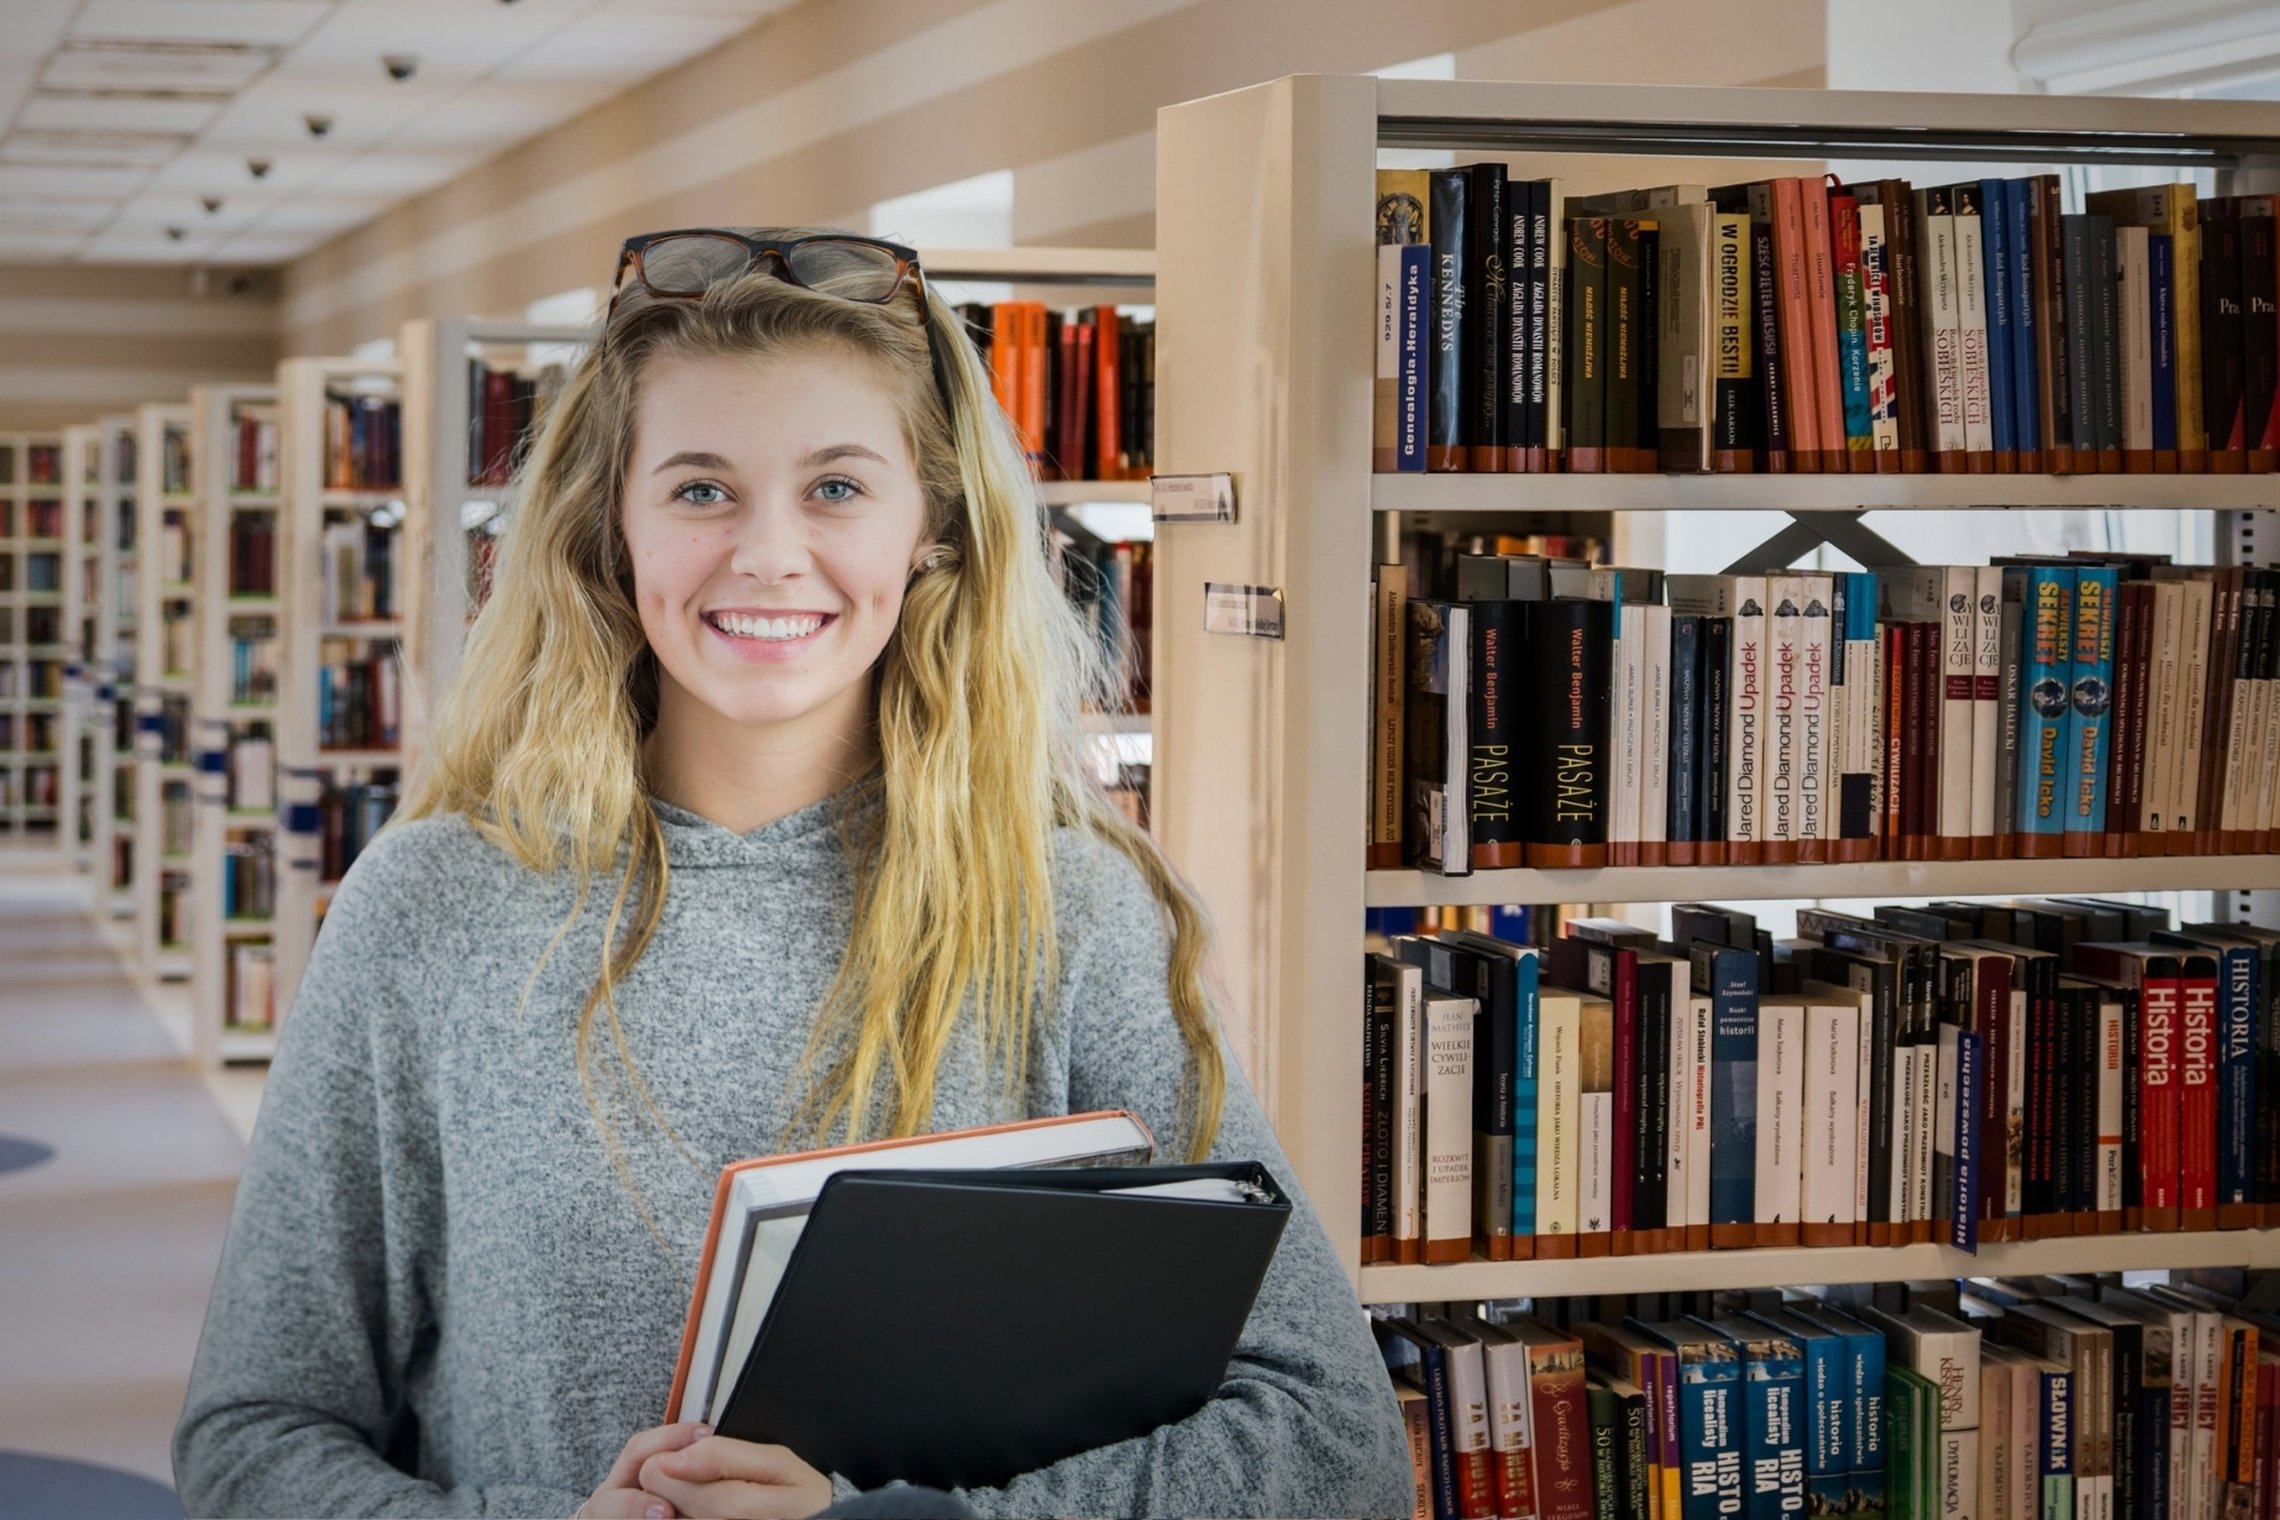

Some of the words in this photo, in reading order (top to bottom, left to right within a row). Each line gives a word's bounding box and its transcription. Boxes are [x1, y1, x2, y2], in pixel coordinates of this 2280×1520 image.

[1513, 214, 1526, 246] ANDREW
[1532, 214, 1547, 246] ANDREW
[1721, 223, 1738, 239] W
[1938, 232, 1949, 272] Aleksandra
[1966, 232, 1977, 272] Aleksandra
[1513, 248, 1526, 269] COOK
[1532, 248, 1547, 269] COOK
[1721, 242, 1738, 320] OGRODZIE
[1867, 235, 1880, 286] TAJEMNICE
[1995, 252, 2005, 272] Ród
[2020, 253, 2030, 273] Ród
[1384, 282, 1393, 342] 929.5/.7
[1440, 253, 1454, 352] KENNEDYS
[1513, 281, 1526, 317] ZAGŁADA
[1532, 281, 1547, 316] ZAGŁADA
[1871, 290, 1885, 342] WINDSORÓW
[1995, 273, 2009, 326] Bonapartych
[2020, 274, 2033, 328] Bonapartych
[2159, 287, 2168, 309] Klątwa
[2160, 312, 2168, 327] rodu
[1513, 317, 1526, 350] DYNASTII
[1532, 316, 1547, 350] DYNASTII
[1721, 324, 1738, 374] BESTII
[1845, 263, 1857, 307] Fryderyk
[1851, 349, 1863, 393] Korzenie
[1949, 329, 1960, 362] Rozkwit
[1977, 329, 1987, 362] Rozkwit
[2161, 329, 2169, 368] Grimaldich
[1404, 263, 1420, 456] Genealogia.Heraldyka
[1513, 351, 1526, 405] ROMANOWÓW
[1532, 351, 1547, 405] ROMANOWÓW
[1935, 328, 1954, 426] SOBIESKICH
[1962, 328, 1981, 426] SOBIESKICH
[1953, 398, 1962, 425] rodu
[1981, 398, 1991, 425] rodu
[2036, 581, 2059, 667] SEKRET
[2058, 588, 2071, 661] NAJWIĘKSZY
[2077, 580, 2101, 665] SEKRET
[2100, 588, 2113, 661] NAJWIĘKSZY
[1485, 628, 1498, 668] Walter
[1570, 628, 1584, 668] Walter
[1740, 641, 1759, 711] Upadek
[1776, 641, 1796, 711] Upadek
[1804, 641, 1825, 711] Upadek
[1892, 663, 1902, 735] EGZOTYCZNE
[2006, 663, 2018, 702] OSKAR
[2162, 693, 2171, 705] dla
[2163, 660, 2173, 692] Historia
[2192, 663, 2201, 695] Historia
[1483, 671, 1498, 730] Benjamin
[1568, 671, 1584, 730] Benjamin
[1832, 686, 1842, 721] HISTORIA
[2191, 696, 2200, 709] dla
[2236, 680, 2248, 721] GRANICE
[2005, 703, 2017, 750] HALECKI
[2082, 726, 2098, 774] David
[2159, 706, 2169, 747] wyobraźni
[2188, 710, 2198, 750] wyobraźni
[2232, 723, 2243, 762] HISTORII
[1737, 714, 1755, 791] Diamond
[1774, 714, 1791, 791] Diamond
[1802, 714, 1820, 791] Diamond
[2041, 727, 2057, 774] David
[1473, 744, 1514, 823] PASAŻE
[1557, 744, 1598, 823] PASAŻE
[1889, 737, 1901, 816] CYWILIZACJE
[2038, 779, 2054, 819] Icke
[2078, 777, 2096, 816] Icke
[1736, 793, 1754, 842] Jared
[1773, 793, 1791, 842] Jared
[1801, 793, 1818, 841] Jared
[1696, 1007, 1707, 1028] Rafał
[1719, 1025, 1754, 1035] historii
[1720, 1016, 1754, 1024] pomocnicze
[1776, 1018, 1784, 1039] Maria
[1829, 1018, 1838, 1039] Maria
[2230, 957, 2250, 1058] HISTORIA
[1431, 1040, 1471, 1052] WIELKIE
[1431, 1052, 1471, 1064] CYWILI-
[1696, 1029, 1707, 1064] Stobiecki
[1775, 1040, 1784, 1075] Todorova
[1829, 1040, 1838, 1075] Todorova
[2107, 1019, 2119, 1070] HISTORIA
[2146, 987, 2176, 1086] Historia
[2184, 987, 2214, 1086] Historia
[1437, 1064, 1466, 1076] ZACJE
[1498, 1072, 1507, 1094] Teoria
[1694, 1065, 1706, 1114] Historiografia
[1903, 1055, 1912, 1108] PRZESZŁOŚĆ
[1921, 1053, 1931, 1105] PRZESZŁOŚĆ
[1498, 1101, 1507, 1128] historia
[1553, 1082, 1562, 1116] HISTORIA
[1921, 1106, 1929, 1129] JAKO
[1959, 1037, 1972, 1160] powszechna
[1377, 1110, 1390, 1160] ZŁOTO
[1552, 1117, 1562, 1136] JAKO
[1695, 1116, 1704, 1131] PRL
[1773, 1121, 1783, 1167] wyobrażone
[1826, 1121, 1836, 1167] wyobrażone
[1432, 1154, 1470, 1165] ROZKWIT
[1438, 1164, 1470, 1174] UPADEK
[1552, 1137, 1561, 1167] WIEDZA
[1902, 1133, 1910, 1180] PRZEDMIOT
[1920, 1130, 1929, 1177] PRZEDMIOT
[1430, 1173, 1471, 1184] IMPERIÓW
[1552, 1167, 1561, 1202] LOKALNA
[1956, 1165, 1968, 1244] Historia
[1817, 1356, 1827, 1389] wiedza
[1855, 1353, 1865, 1386] wiedza
[2244, 1339, 2255, 1390] HISTORIA
[1645, 1381, 1655, 1434] repetytorium
[1666, 1384, 1677, 1443] repetytorium
[1938, 1356, 1954, 1424] KISSINGER
[1951, 1367, 1965, 1413] HENRY
[2171, 1383, 2192, 1431] JEŃCY
[2197, 1383, 2219, 1431] JEŃCY
[1413, 1413, 1422, 1437] ALAIN
[1552, 1400, 1573, 1472] Cywilizacja
[1596, 1426, 1612, 1447] 50
[1628, 1407, 1640, 1427] 50
[1701, 1389, 1718, 1449] licealisty
[1717, 1388, 1728, 1448] Kompendium
[1764, 1387, 1781, 1446] licealisty
[1780, 1386, 1792, 1445] Kompendium
[1815, 1399, 1828, 1470] społeczeństwie
[1830, 1400, 1843, 1456] historia
[1854, 1395, 1866, 1465] społeczeństwie
[1868, 1395, 1881, 1452] historia
[2241, 1392, 2254, 1474] POWSZECHNA
[1414, 1437, 1424, 1468] DECAUX
[1754, 1458, 1780, 1494] RIA
[1691, 1460, 1718, 1496] RIA
[1717, 1450, 1742, 1514] HISTO
[1780, 1448, 1804, 1512] HISTO
[1945, 1440, 1960, 1514] DYPLOMACJA
[1994, 1444, 2004, 1514] TAJEMNICE
[2024, 1442, 2034, 1513] TAJEMNICE
